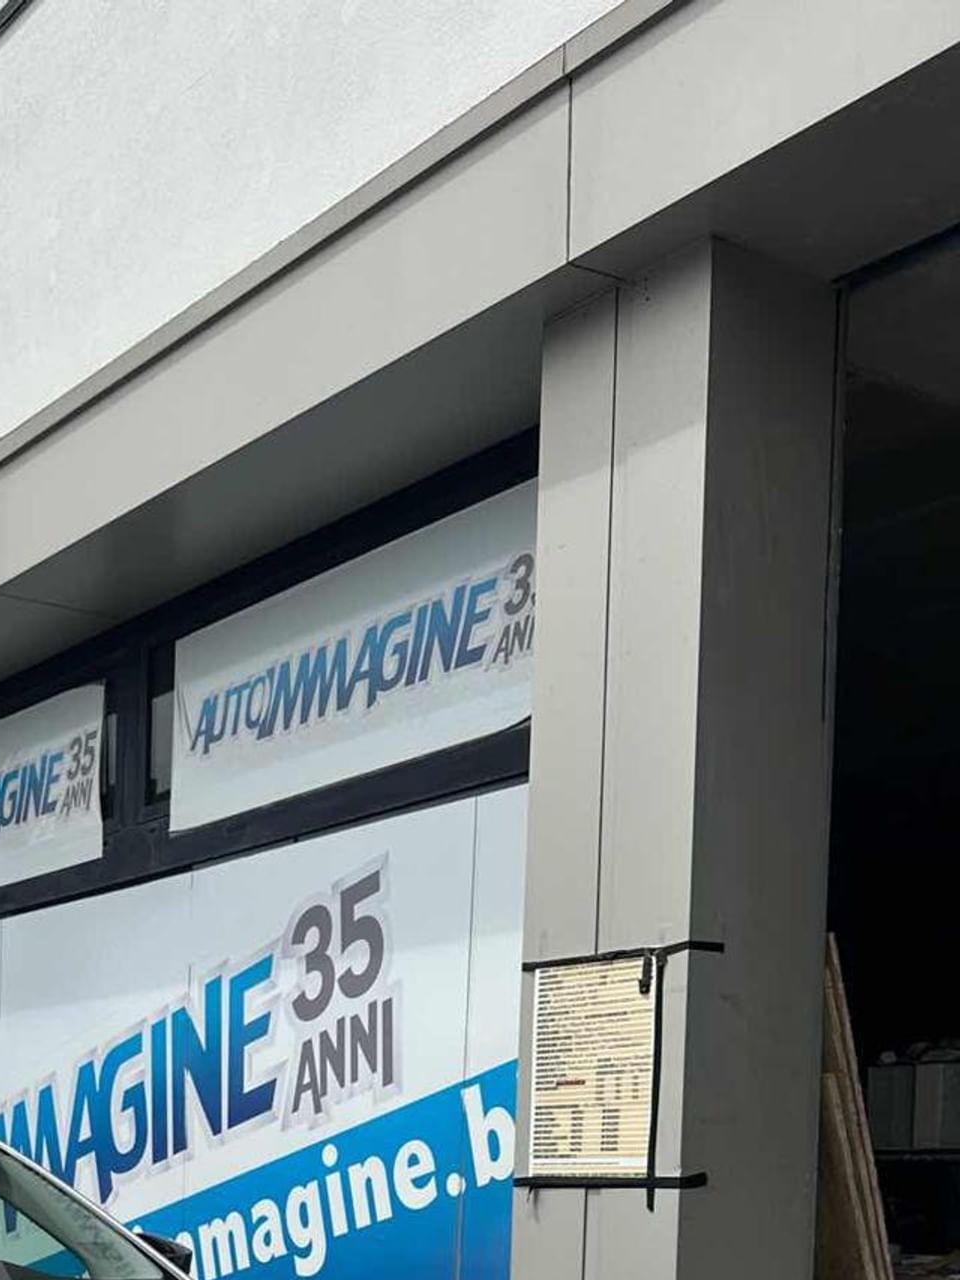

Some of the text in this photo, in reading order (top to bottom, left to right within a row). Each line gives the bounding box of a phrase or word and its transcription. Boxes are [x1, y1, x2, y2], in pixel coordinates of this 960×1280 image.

[191, 553, 536, 755] AUTOIMMAGINE 3
[492, 614, 535, 665] AN
[60, 778, 94, 817] ANNI
[67, 730, 98, 781] 35
[291, 869, 385, 1023] 35
[291, 997, 394, 1115] ANNI
